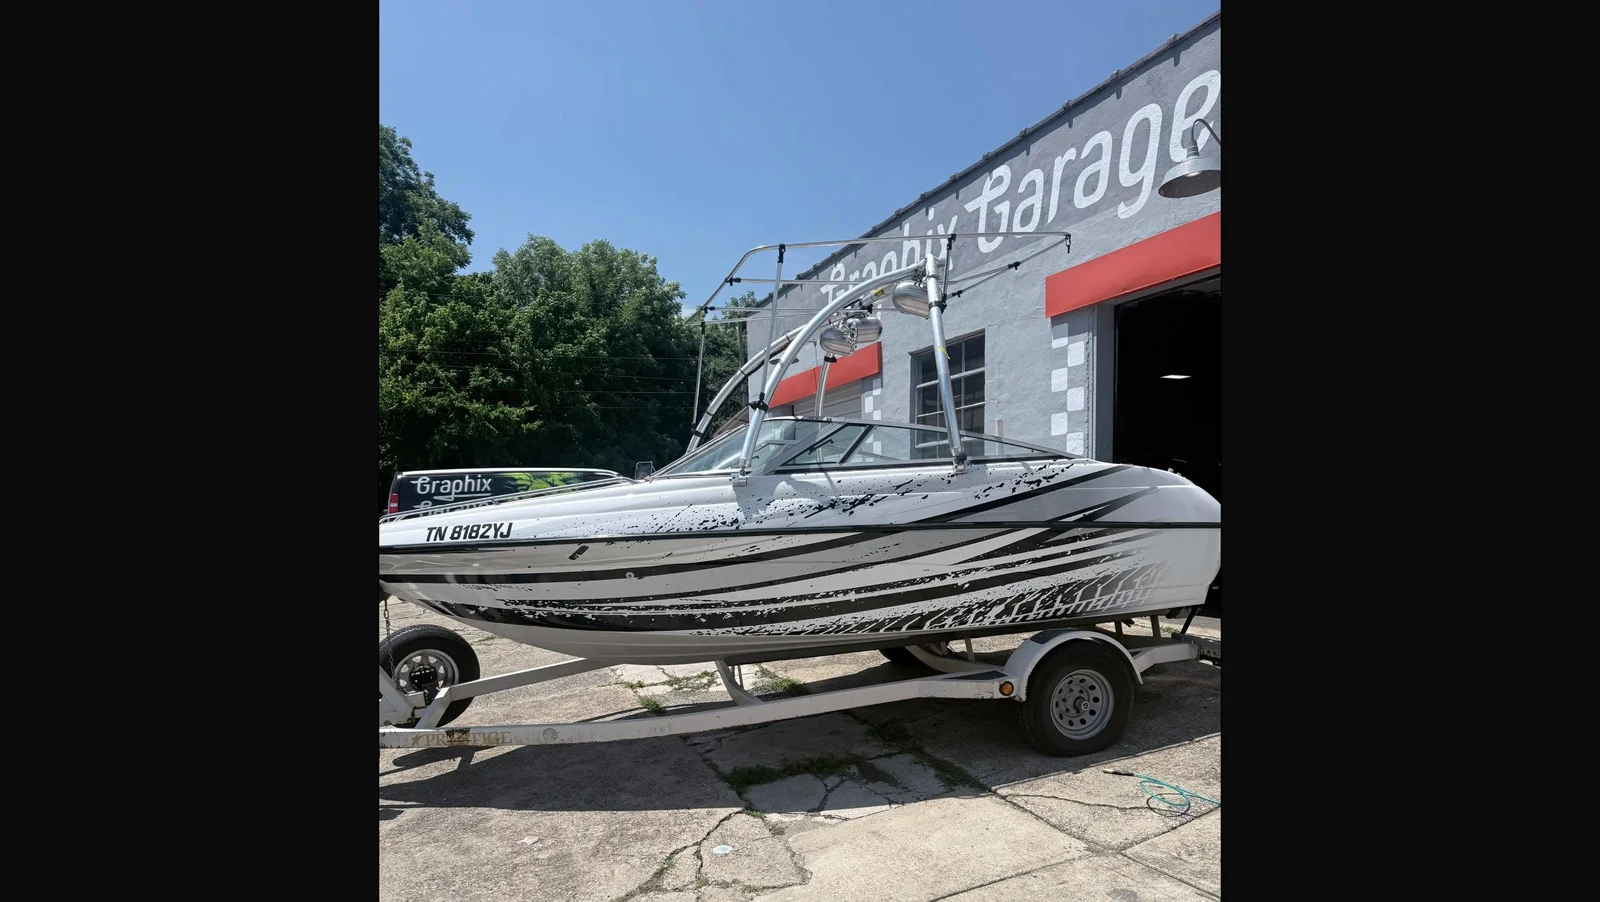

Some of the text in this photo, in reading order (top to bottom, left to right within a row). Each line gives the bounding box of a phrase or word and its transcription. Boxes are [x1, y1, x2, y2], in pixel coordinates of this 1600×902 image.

[964, 70, 1221, 253] Garage
[410, 474, 492, 501] Graphix
[426, 522, 513, 541] TN 8182YJ
[426, 731, 512, 747] PRTIGE
